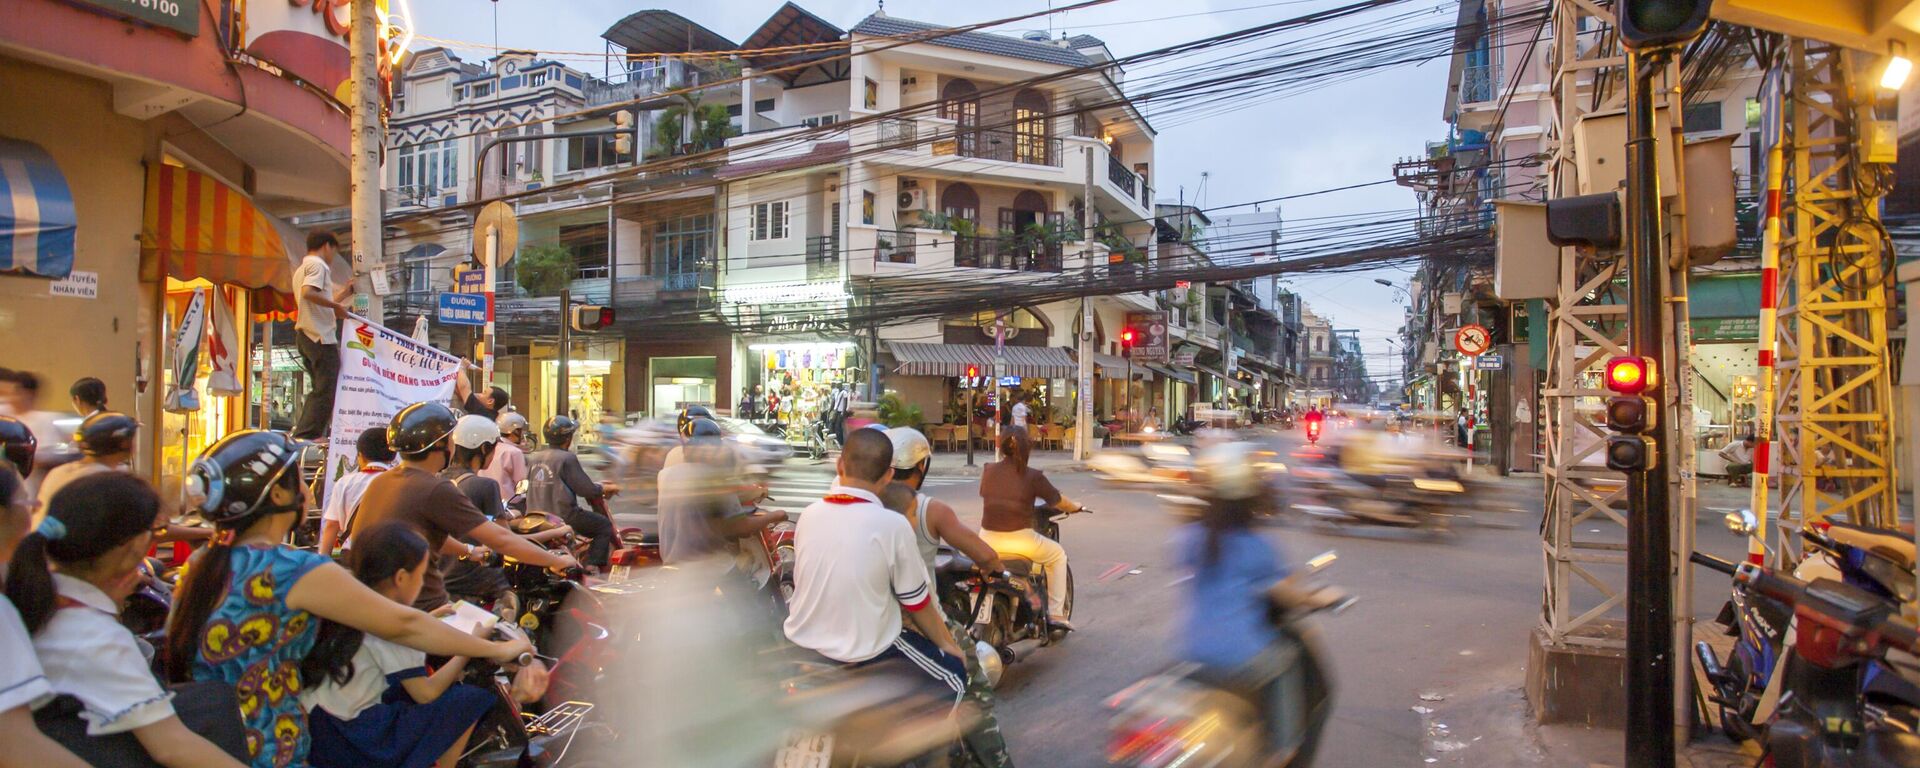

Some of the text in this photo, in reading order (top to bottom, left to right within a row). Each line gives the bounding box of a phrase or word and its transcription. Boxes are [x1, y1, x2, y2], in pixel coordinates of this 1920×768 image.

[53, 285, 95, 296] NHÂN VIÊN
[451, 296, 476, 306] ĐƯỜNG
[454, 308, 471, 319] QUANG
[420, 379, 441, 387] SINH
